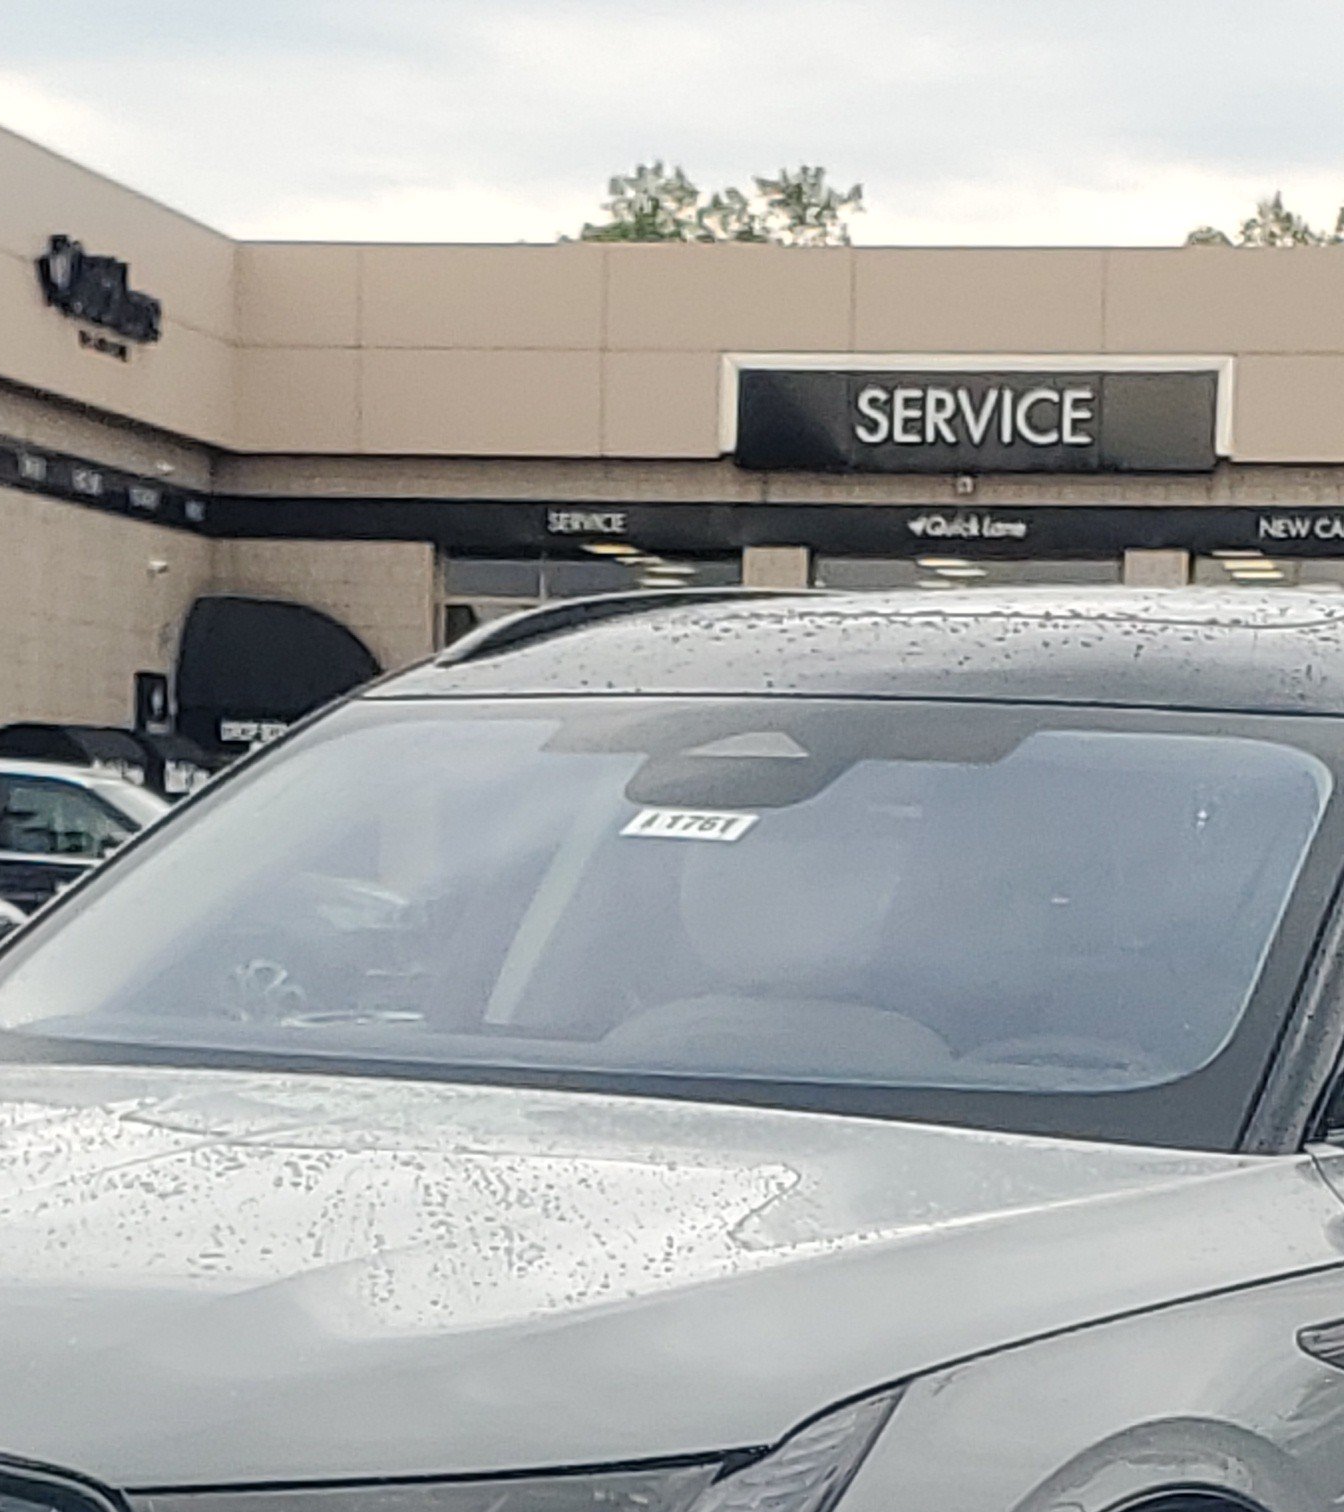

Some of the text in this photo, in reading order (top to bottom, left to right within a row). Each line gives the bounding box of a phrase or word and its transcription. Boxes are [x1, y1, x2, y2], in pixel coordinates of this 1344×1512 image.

[855, 386, 1094, 445] SERVICE
[546, 511, 628, 533] SERVICE
[1259, 515, 1310, 539] NEW
